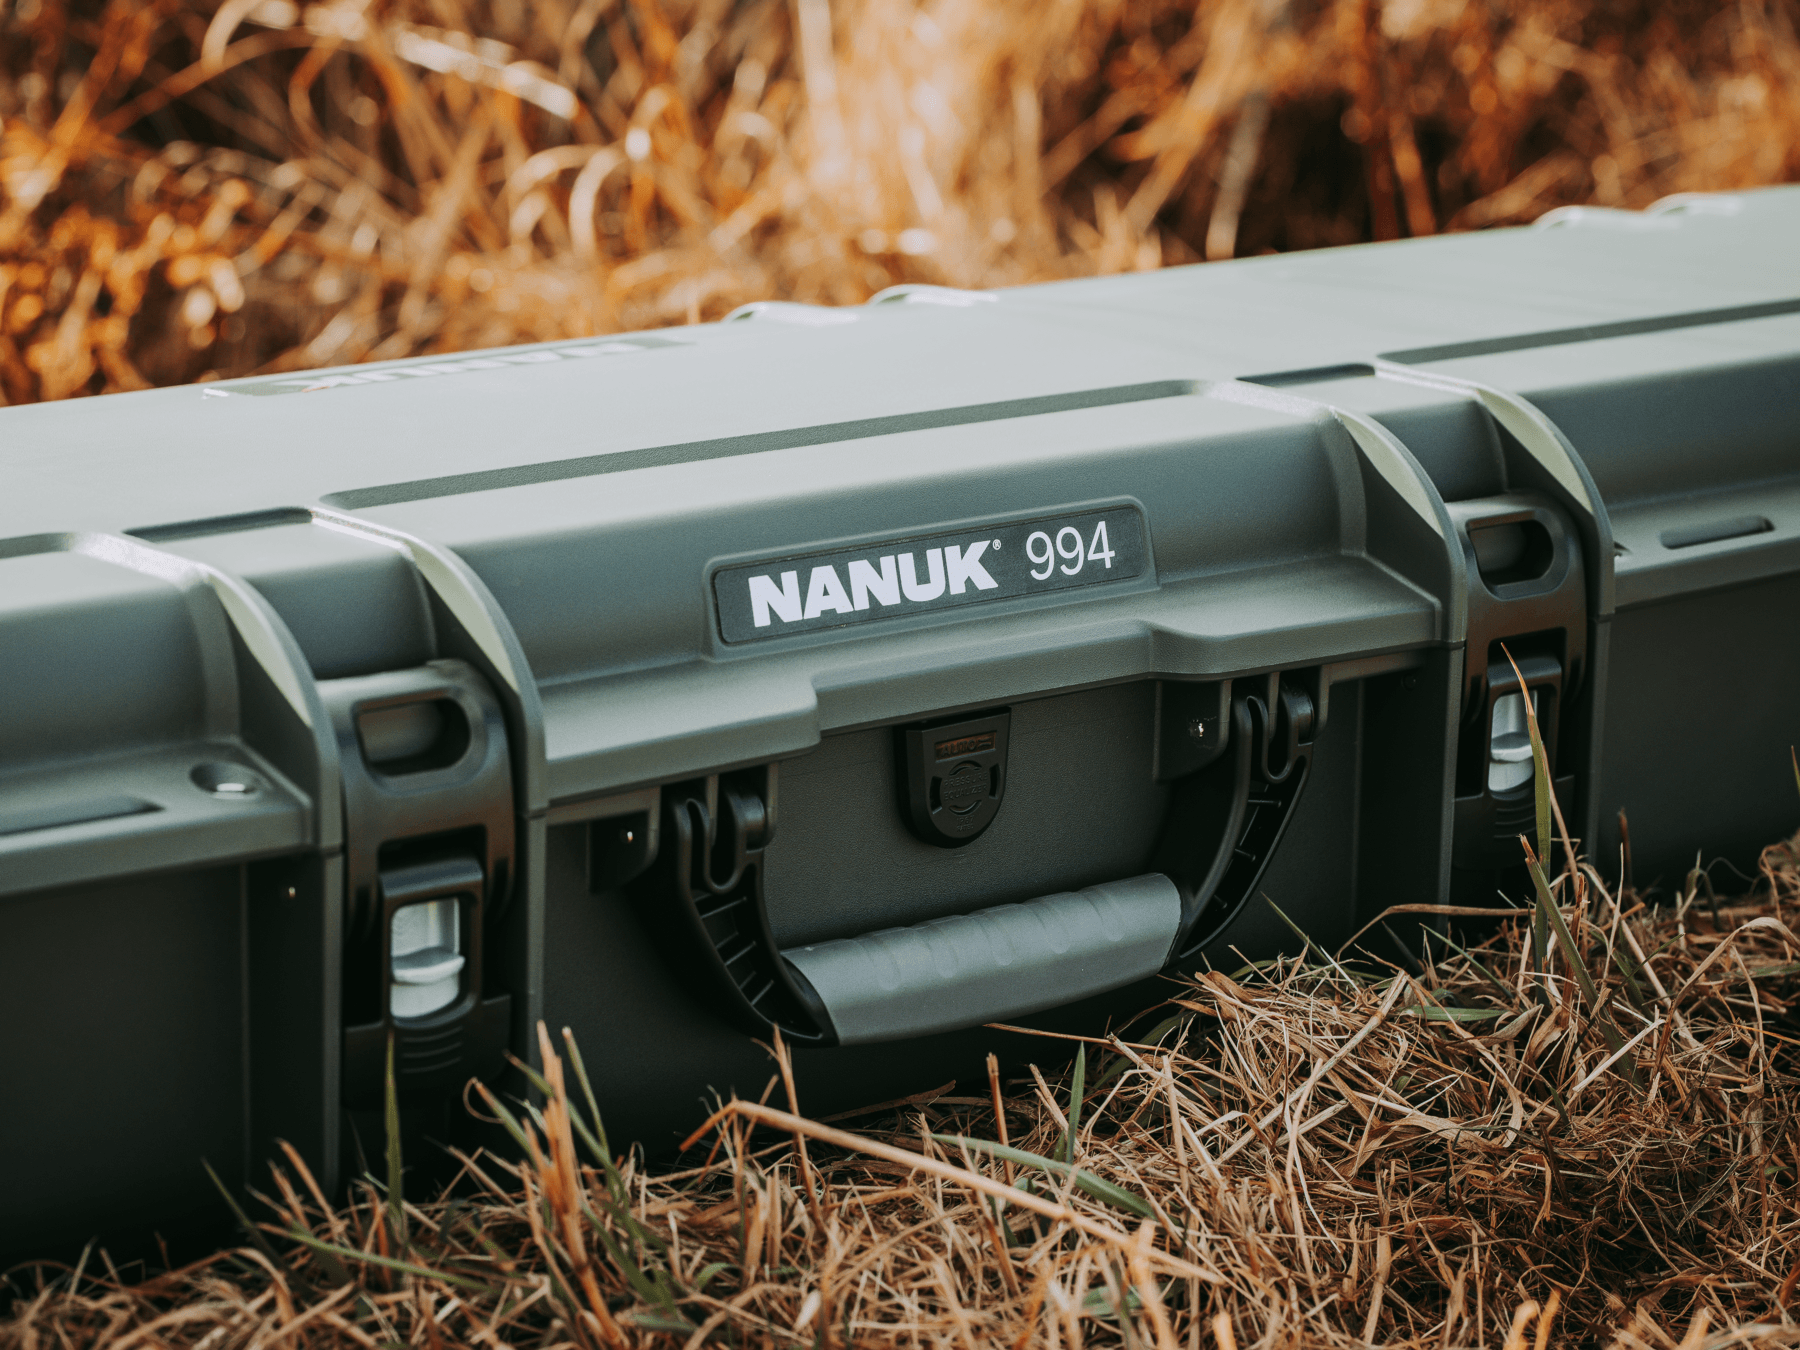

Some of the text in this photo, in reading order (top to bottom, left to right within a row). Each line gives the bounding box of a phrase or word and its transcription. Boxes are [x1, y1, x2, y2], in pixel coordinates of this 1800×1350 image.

[1025, 520, 1116, 581] 994
[941, 739, 977, 757] AUTO
[943, 771, 988, 789] PRESSURE
[943, 784, 988, 802] EQUALIZER
